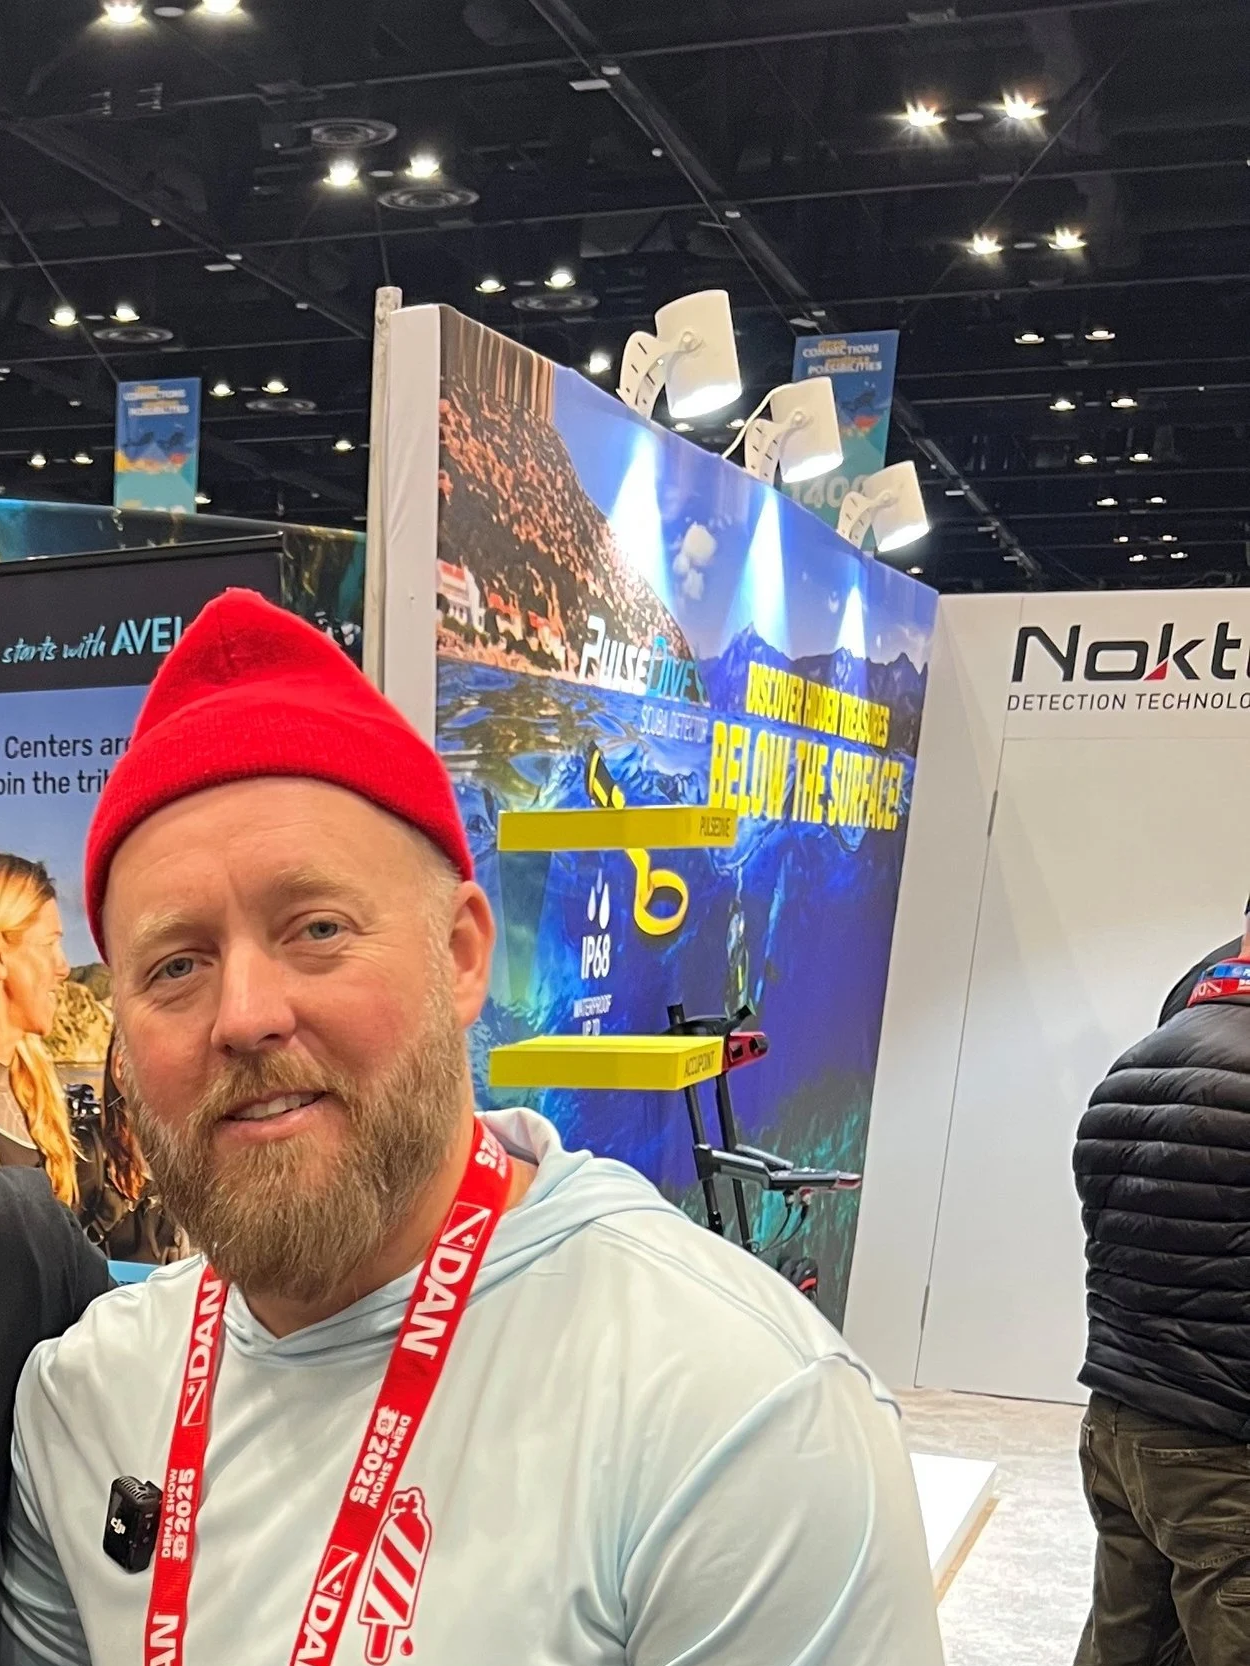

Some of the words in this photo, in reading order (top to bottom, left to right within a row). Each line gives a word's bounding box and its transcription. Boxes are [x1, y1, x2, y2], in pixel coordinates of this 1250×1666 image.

[2, 635, 58, 665] starts
[62, 624, 106, 660] with
[1011, 621, 1250, 683] Nokt
[745, 660, 804, 726] DISCOVER
[803, 679, 841, 736] HIDDEN
[839, 691, 891, 749] TREASURES
[1006, 693, 1127, 712] DETECTION
[4, 734, 93, 759] Centers
[32, 770, 71, 795] the
[709, 719, 792, 822] BELOW
[792, 739, 830, 824] THE
[827, 747, 905, 832] SURFACE!
[580, 933, 612, 980] IP68
[400, 1245, 474, 1360] DAN
[187, 1279, 224, 1380] DAN
[386, 1414, 413, 1459] DEMA
[165, 1468, 180, 1513] SHOW
[349, 1434, 390, 1505] 2025
[366, 1461, 395, 1510] SHOW
[174, 1467, 196, 1535] 2025
[161, 1514, 176, 1559] DEMA
